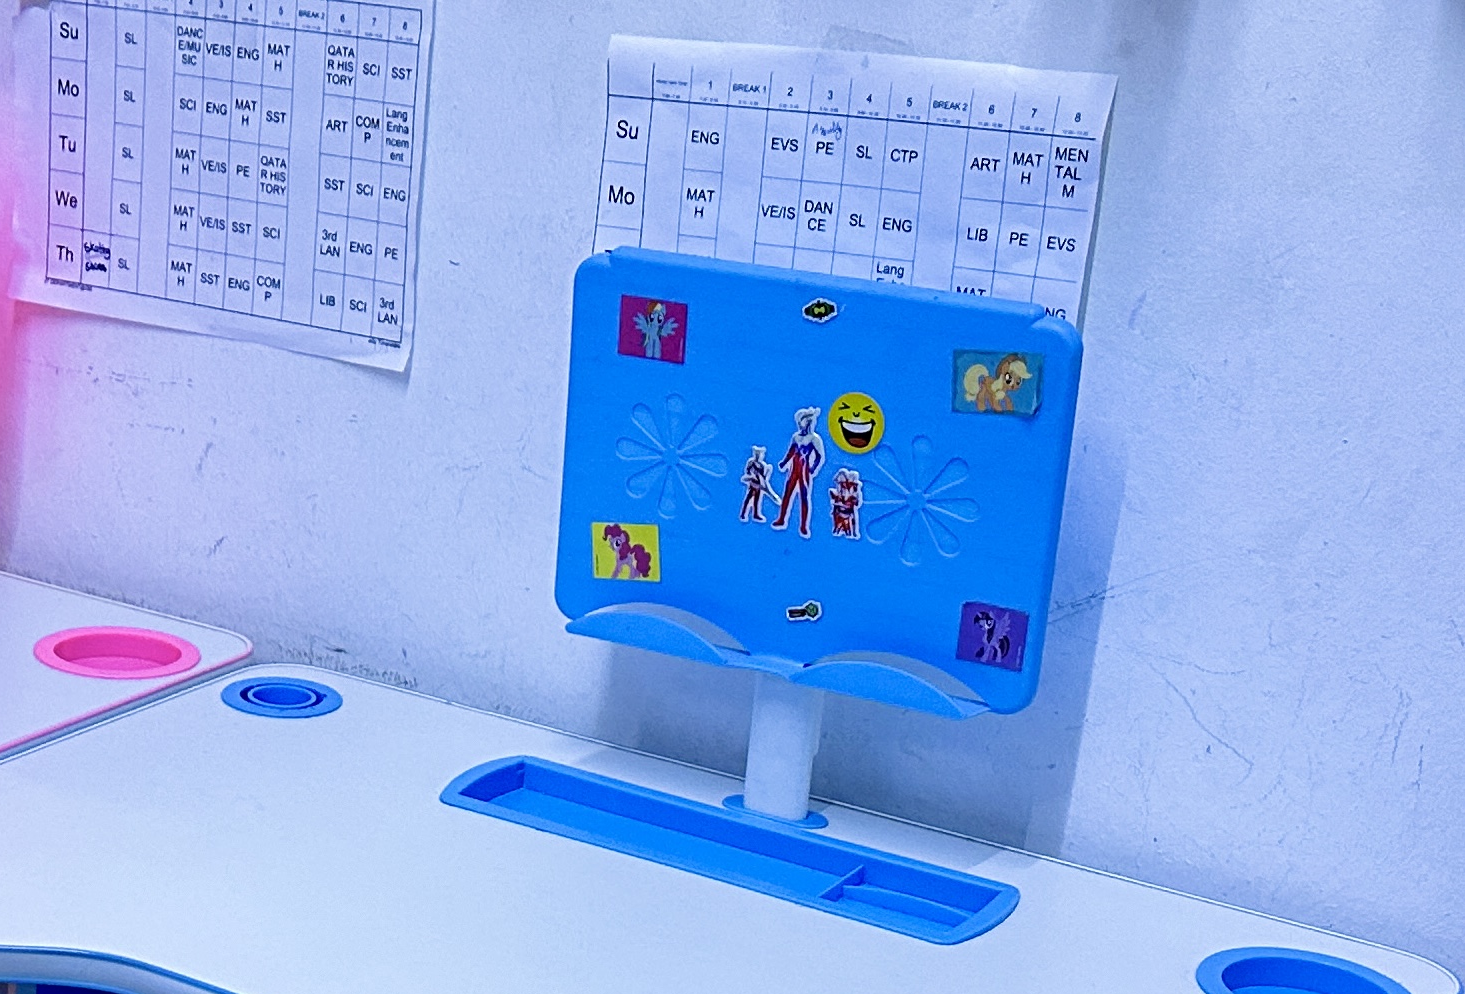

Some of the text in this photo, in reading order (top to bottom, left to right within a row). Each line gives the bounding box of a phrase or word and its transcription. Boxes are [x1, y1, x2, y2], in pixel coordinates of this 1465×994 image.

[298, 10, 319, 18] BREAK
[59, 22, 79, 40] Su
[177, 26, 203, 40] DANC
[124, 32, 137, 45] SL
[178, 40, 201, 53] E/MU
[206, 44, 232, 57] VE/IS
[237, 46, 259, 61] ENG
[267, 43, 291, 56] MAT
[327, 44, 355, 58] QATA
[181, 53, 197, 66] SIC
[274, 60, 282, 72] H
[327, 59, 354, 73] R HIS
[362, 62, 381, 76] SCI
[391, 66, 413, 80] SST
[326, 73, 354, 87] TORY
[708, 80, 713, 90] 1
[58, 78, 79, 97] Mo
[733, 83, 760, 93] BREAK
[787, 86, 793, 97] 2
[123, 90, 136, 103] SL
[827, 90, 833, 100] 3
[866, 94, 872, 103] 4
[179, 98, 197, 111] SCI
[205, 101, 227, 116] ENG
[235, 98, 257, 112] MAT
[906, 97, 913, 108] 5
[933, 100, 969, 112] BREAK 2
[988, 104, 995, 115] 6
[266, 110, 287, 124] SST
[386, 108, 408, 122] Lang
[1031, 108, 1038, 118] 7
[1074, 112, 1081, 123] 8
[241, 115, 249, 126] H
[325, 119, 348, 133] ART
[355, 115, 380, 129] COM
[386, 121, 409, 135] Enha
[616, 120, 639, 140] Su
[59, 135, 76, 153] Tu
[364, 132, 371, 143] P
[385, 137, 409, 149] ncem
[691, 130, 719, 145] ENG
[771, 137, 799, 152] EVS
[122, 146, 134, 160] SL
[175, 148, 197, 161] MAT
[815, 141, 835, 156] PE
[855, 145, 873, 160] SL
[261, 156, 287, 168] QATA
[389, 152, 404, 162] ent
[890, 148, 919, 164] CTP
[1013, 152, 1044, 168] MAT
[1054, 146, 1089, 168] MEN
[181, 164, 189, 175] H
[201, 160, 227, 174] VE/IS
[236, 164, 250, 178] PE
[970, 157, 1001, 172] ART
[261, 169, 286, 183] R HIS
[1020, 171, 1031, 185] H
[1055, 165, 1082, 181] TAL
[260, 182, 286, 195] TORY
[324, 178, 345, 192] SST
[356, 183, 373, 197] SCI
[1062, 184, 1075, 198] M
[55, 190, 78, 209] We
[383, 187, 406, 202] ENG
[608, 185, 635, 206] Mo
[686, 188, 715, 202] MAT
[119, 202, 131, 215] SL
[173, 204, 195, 218] MAT
[694, 206, 704, 218] H
[762, 204, 796, 220] VE/IS
[804, 200, 833, 215] DAN
[179, 220, 187, 231] H
[200, 217, 225, 230] VE/IS
[231, 221, 252, 234] SST
[807, 218, 827, 232] CE
[849, 213, 865, 228] SL
[882, 217, 912, 233] ENG
[263, 226, 281, 240] SCI
[322, 228, 337, 242] 3rd
[967, 227, 988, 242] LIB
[1009, 232, 1029, 247] PE
[349, 241, 373, 256] ENG
[1047, 236, 1077, 252] EVS
[56, 245, 74, 262] Th
[320, 245, 341, 258] LAN
[384, 246, 398, 260] PE
[117, 258, 130, 271] SL
[171, 260, 193, 274] MAT
[876, 262, 905, 278] Lang
[177, 276, 185, 286] H
[200, 272, 220, 285] SST
[228, 277, 250, 291] ENG
[256, 275, 281, 290] COM
[264, 291, 272, 301] P
[319, 294, 336, 307] LIB
[349, 299, 367, 313] SCI
[379, 297, 395, 310] 3rd
[377, 312, 398, 326] LAN
